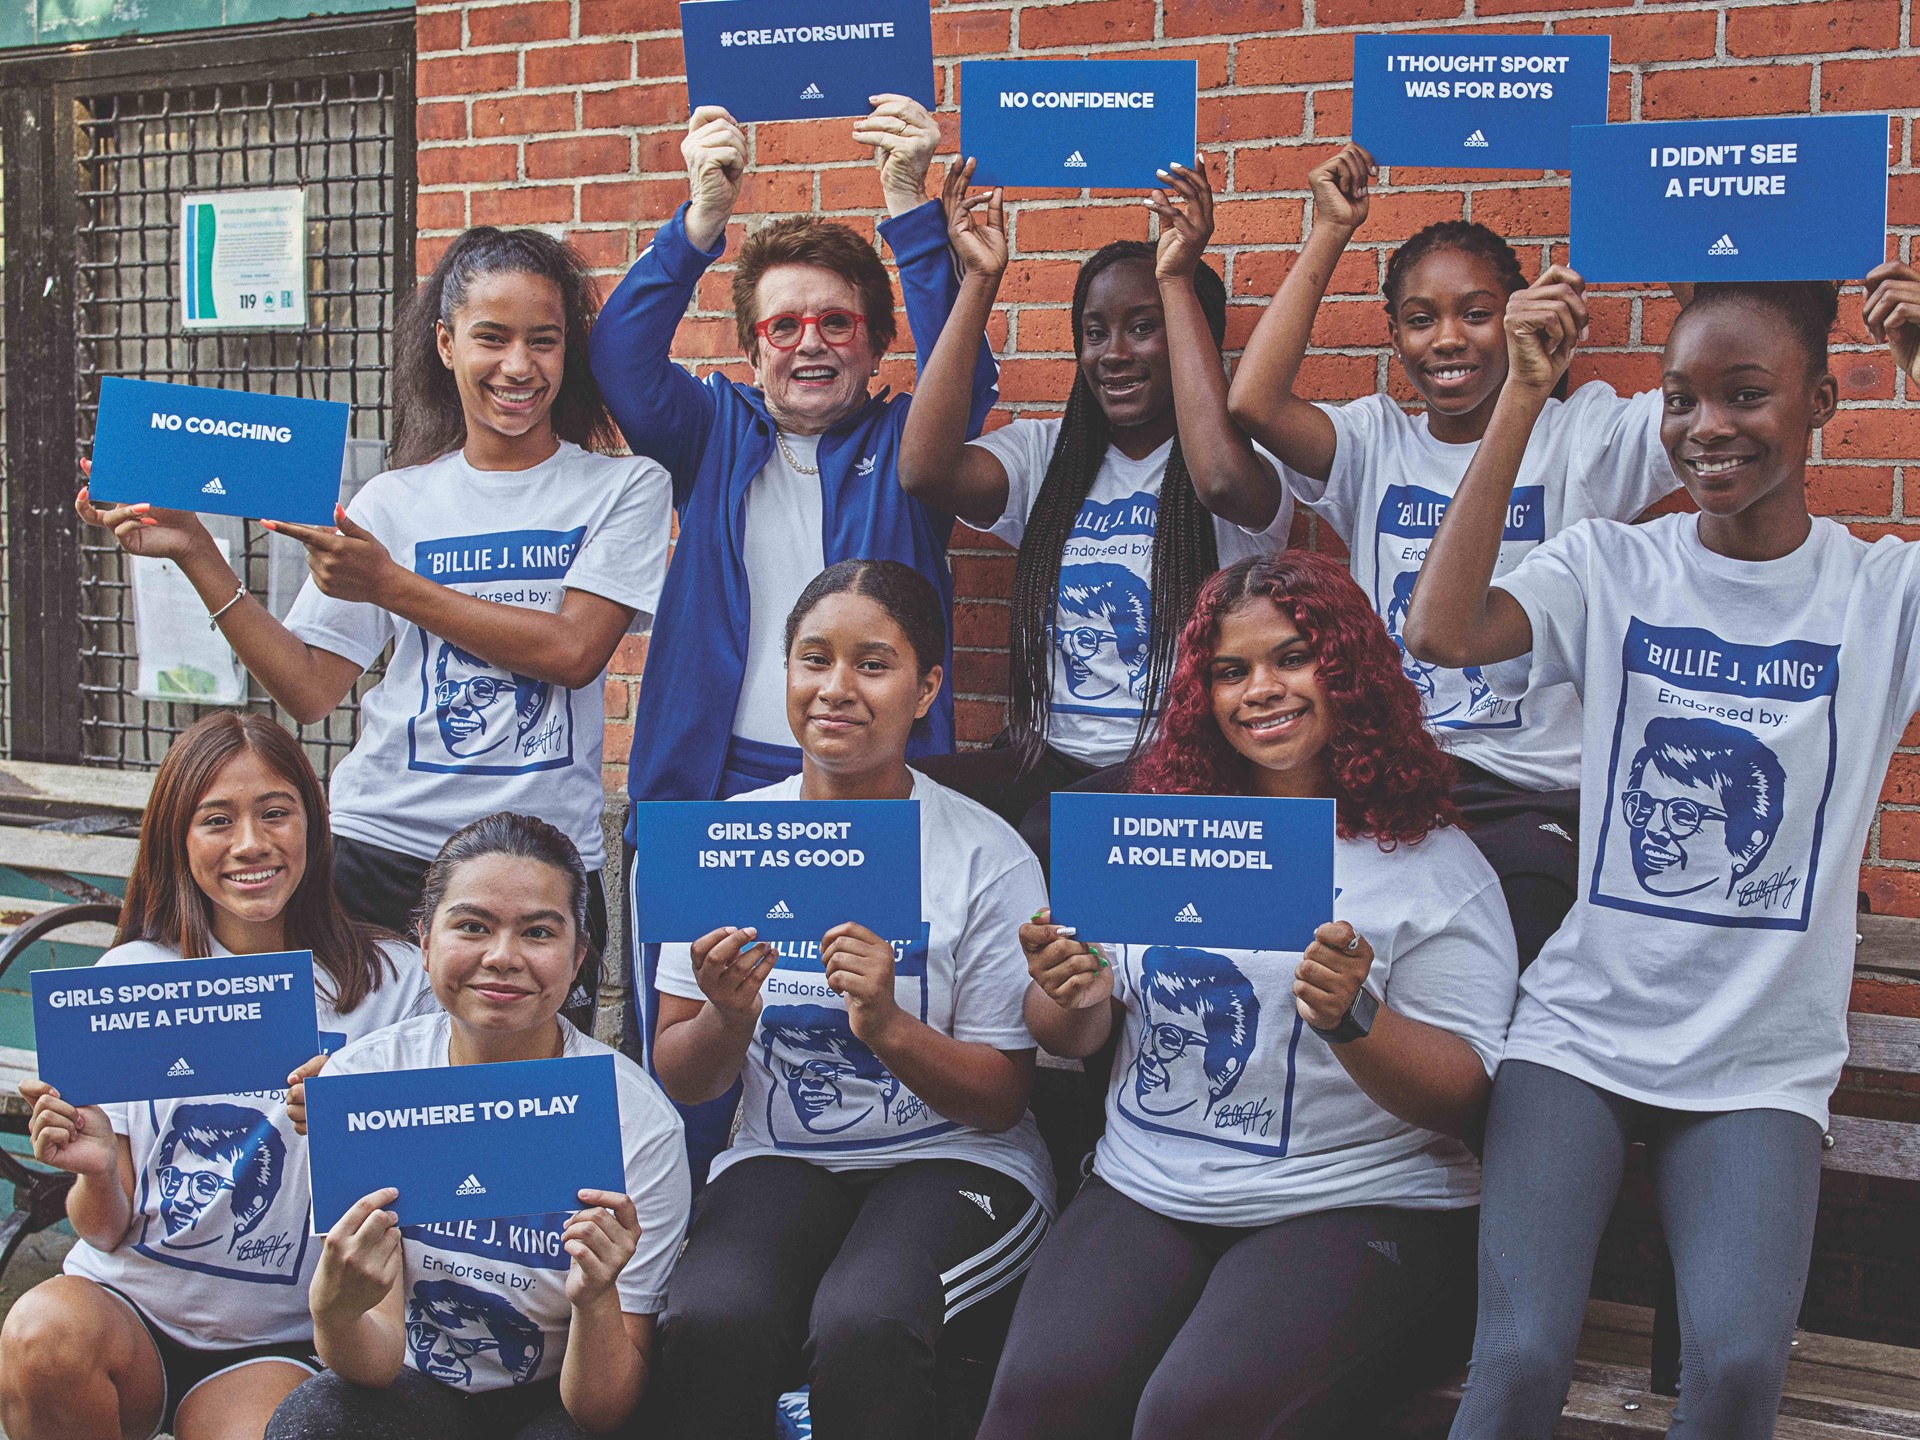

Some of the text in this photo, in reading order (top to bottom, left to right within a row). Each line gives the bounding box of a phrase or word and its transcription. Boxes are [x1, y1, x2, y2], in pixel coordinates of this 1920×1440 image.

[720, 22, 895, 47] #CREATORSUNITE
[1387, 56, 1569, 73] I THOUGHT SPORT
[800, 92, 824, 100] adidas
[1405, 81, 1553, 99] WAS FOR BOYS
[1000, 92, 1154, 108] NO CONFIDENCE
[1650, 143, 1798, 167] I DIDN’T SEE
[1664, 175, 1786, 197] A FUTURE
[1707, 247, 1739, 255] adidas
[239, 294, 257, 309] 119
[151, 412, 292, 443] NO COACHING
[201, 487, 226, 495] adidas
[497, 547, 516, 569] J.
[1063, 543, 1128, 557] Endorsed
[471, 589, 552, 605] orsed by:
[1726, 661, 1747, 686] J.
[1658, 687, 1789, 728] Endorsed by:
[707, 822, 851, 840] GIRLS SPORT
[1113, 817, 1263, 840] I DIDN’T HAVE
[699, 849, 865, 868] ISN’T AS GOOD
[1107, 846, 1273, 870] A ROLE MODEL
[766, 911, 794, 919] adidas
[1174, 915, 1203, 924] adidas
[48, 973, 294, 1009] GIRLS SPORT DOESN’T
[767, 978, 845, 998] Endorse
[90, 1002, 262, 1032] HAVE A FUTURE
[166, 1068, 195, 1077] adidas
[347, 1095, 579, 1132] NOWHERE TO PLAY
[456, 1186, 487, 1196] adidas
[482, 1220, 502, 1248] J.
[509, 1225, 561, 1258] KING
[423, 1254, 537, 1292] Endorsed by:
